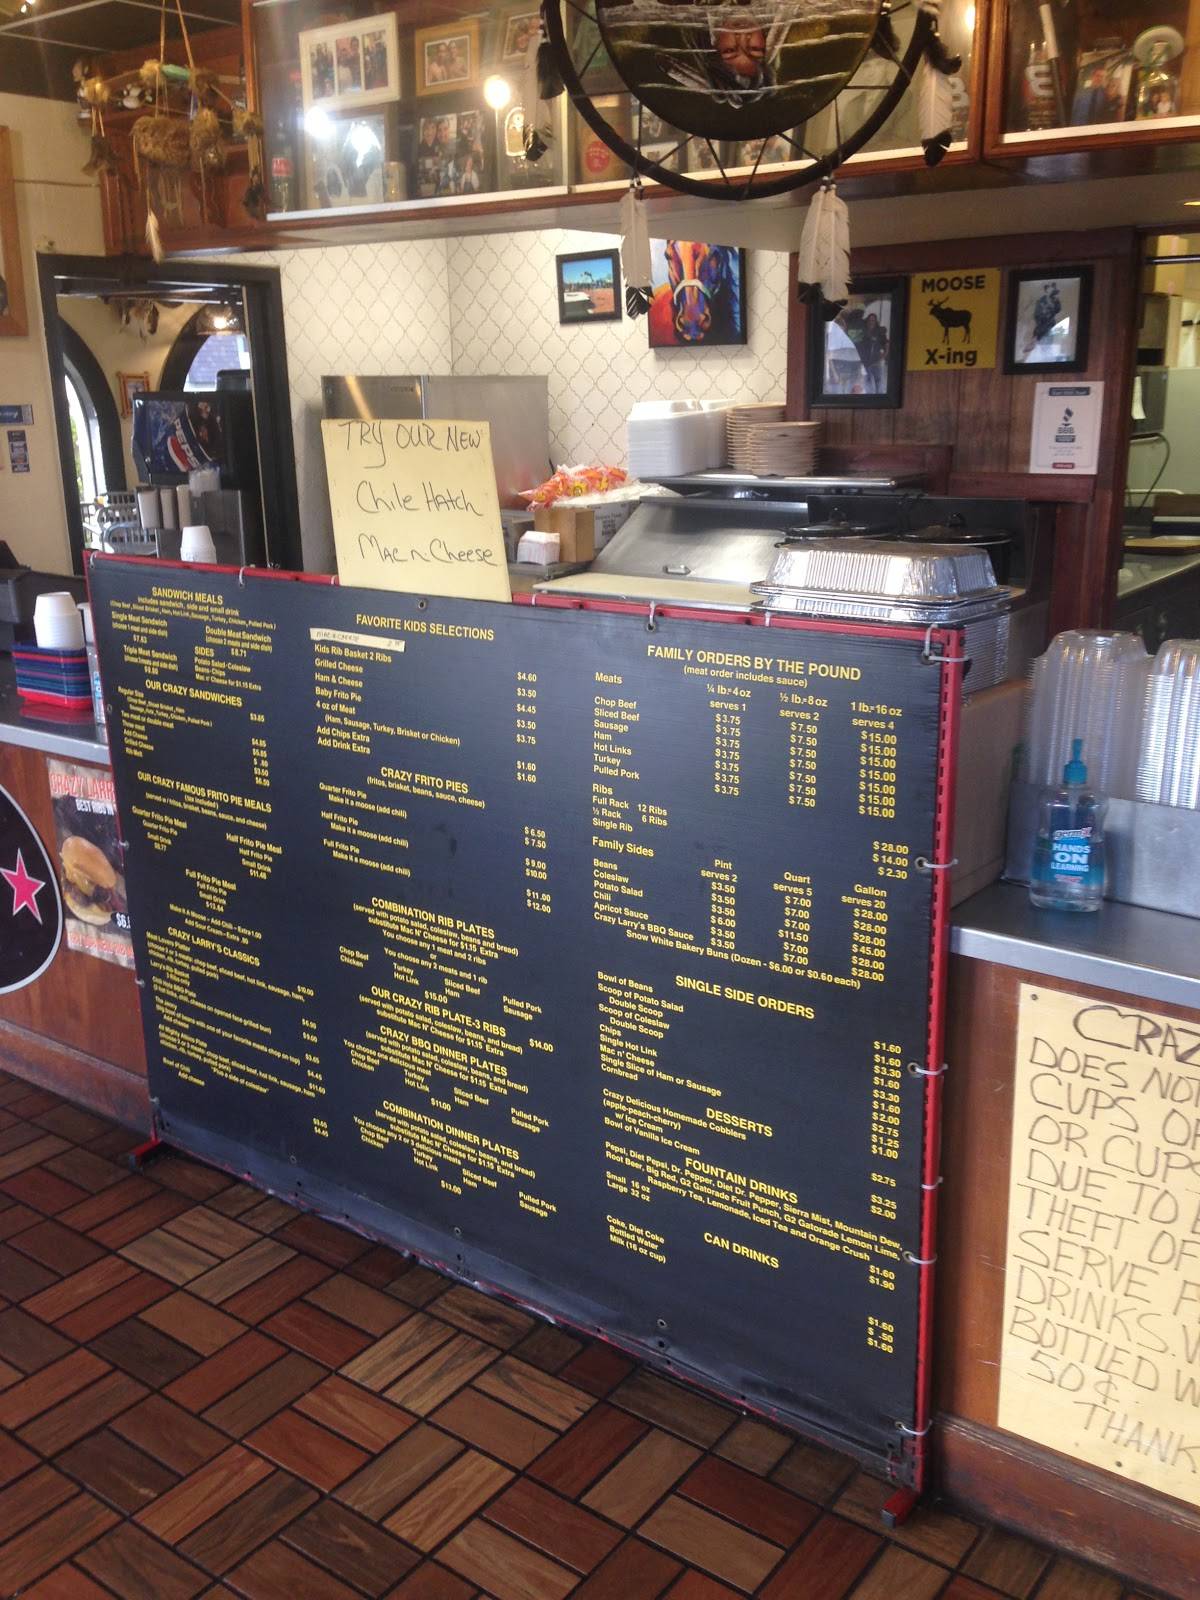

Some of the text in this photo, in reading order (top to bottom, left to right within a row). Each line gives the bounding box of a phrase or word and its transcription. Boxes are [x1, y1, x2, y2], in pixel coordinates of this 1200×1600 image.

[921, 274, 986, 292] MOOSE
[925, 347, 978, 365] X-ing
[339, 420, 482, 468] TRY OUR NEW
[357, 480, 419, 513] Chile
[430, 538, 498, 566] Cheese
[152, 587, 223, 605] SANDWICH MEALS
[356, 614, 494, 640] FAVORITE KIDS SELECTIONS
[194, 646, 214, 658] SIDES
[315, 658, 363, 674] Grilled Cheese
[648, 645, 861, 680] FAMILY ORDERS BY THE POUND
[315, 673, 363, 688] Ham & Cheese
[517, 672, 537, 682] $4.60
[595, 672, 622, 684] Meats
[684, 665, 808, 688] (meat order includes sauce)
[146, 680, 242, 708] OUR CRAZY SANDWICHES
[316, 687, 361, 702] Baby Frito Pie
[594, 697, 637, 709] Chop Beef
[594, 708, 640, 721] Sliced Beef
[317, 726, 370, 743] Add Chips Extra
[594, 720, 629, 732] Sausage
[594, 732, 612, 740] Ham
[318, 738, 370, 754] Add Drink Extra
[594, 743, 632, 755] Hot Links
[594, 754, 621, 766] Turkey
[381, 767, 469, 794] CRAZY FRITO PIES
[593, 766, 640, 779] Pulled Pork
[87, 778, 115, 803] LARR
[137, 771, 272, 813] OUR CRAZY FAMOUS FRITO PIE MEALS
[592, 784, 613, 795] Ribs
[592, 796, 667, 816] Full Rack 12 Ribs
[593, 818, 633, 832] Single Rib
[602, 809, 667, 826] Rack 6 Ribs
[592, 837, 654, 857] Family Sides
[1052, 842, 1091, 854] HANDS
[594, 859, 617, 870] Beans
[1051, 862, 1089, 872] LEARNING
[1054, 852, 1089, 864] ON
[594, 870, 629, 883] Coleslaw
[784, 872, 810, 884] Quart
[594, 881, 643, 897] Potato Salad
[594, 891, 611, 901] Chili
[854, 884, 887, 897] Gallon
[372, 897, 494, 939] COMBINATION RIB PLATES
[594, 903, 648, 920] Apricot Sauce
[594, 912, 694, 941] Crazy Larry's BBQ Sauce
[168, 927, 260, 967] CRAZY LARRY'S CLASSICS
[626, 930, 728, 959] Snow White Bakery Buns
[598, 971, 617, 983] Bowl
[629, 979, 653, 993] Beans
[676, 975, 815, 1019] SINGLE SIDE ORDERS
[371, 986, 390, 1001] OUR
[393, 992, 422, 1010] CRAZY
[425, 1004, 440, 1016] RIB
[483, 1022, 506, 1037] RIBS
[380, 1026, 507, 1076] CRAZY BBQ DINNER PLATES
[1030, 1036, 1128, 1088] DOES
[1030, 1072, 1139, 1133] CUPS
[603, 1088, 747, 1141] Crazy Delicious Homemade Cobblers
[706, 1107, 773, 1137] DESSERTS
[383, 1100, 519, 1160] COMBINATION DINNER PLATES
[872, 1123, 899, 1137] $2.75
[1028, 1114, 1088, 1158] OR
[686, 1157, 798, 1203] FOUNTAIN DRINKS
[1026, 1148, 1179, 1225] DUE TO
[629, 1225, 643, 1236] Diet
[645, 1230, 664, 1244] Coke
[1017, 1183, 1200, 1271] THEFT OF
[704, 1232, 780, 1269] CAN DRINKS
[1013, 1230, 1158, 1304] SERVE
[1175, 1369, 1200, 1408] W
